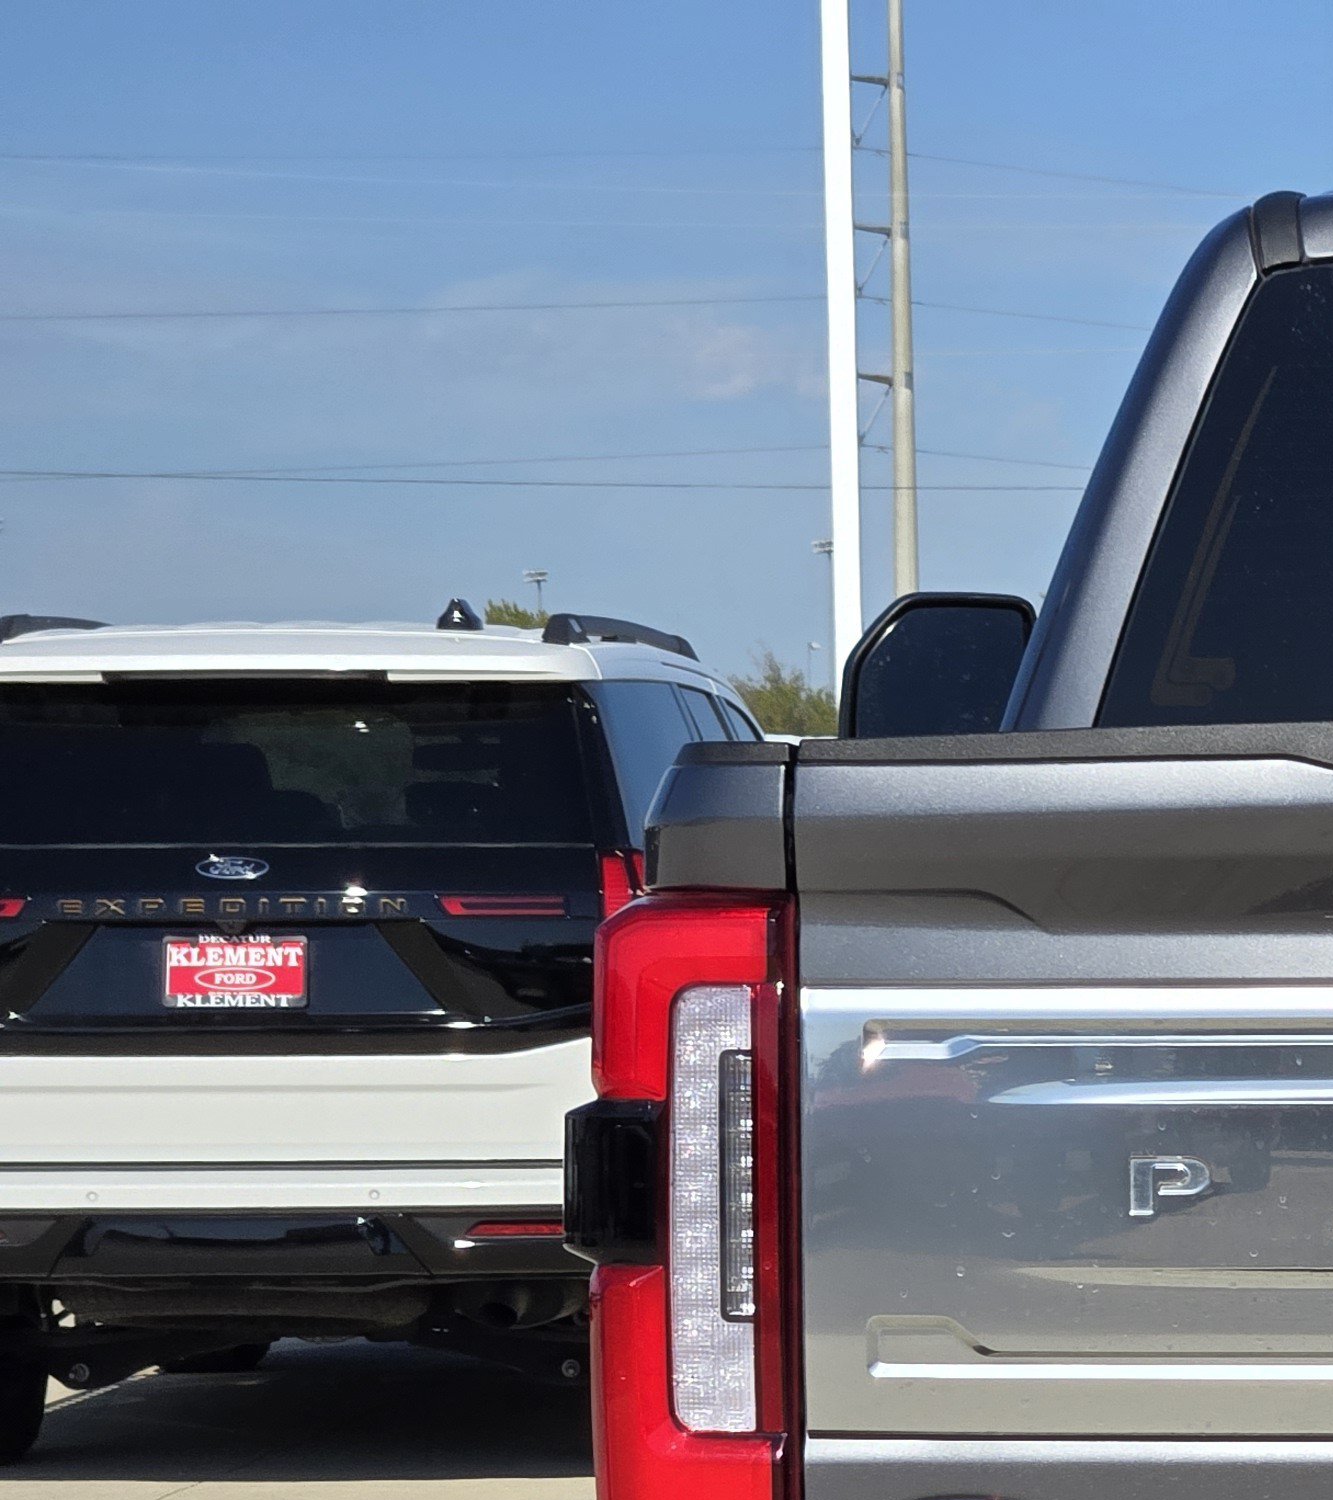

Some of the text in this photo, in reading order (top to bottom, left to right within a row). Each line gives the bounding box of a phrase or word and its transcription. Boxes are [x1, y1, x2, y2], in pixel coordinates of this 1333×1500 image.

[57, 898, 407, 917] EXPEDITION
[199, 934, 271, 944] DECATUR
[169, 946, 303, 967] KLEMENT
[214, 973, 257, 985] FORD
[176, 994, 294, 1007] KLEMENT
